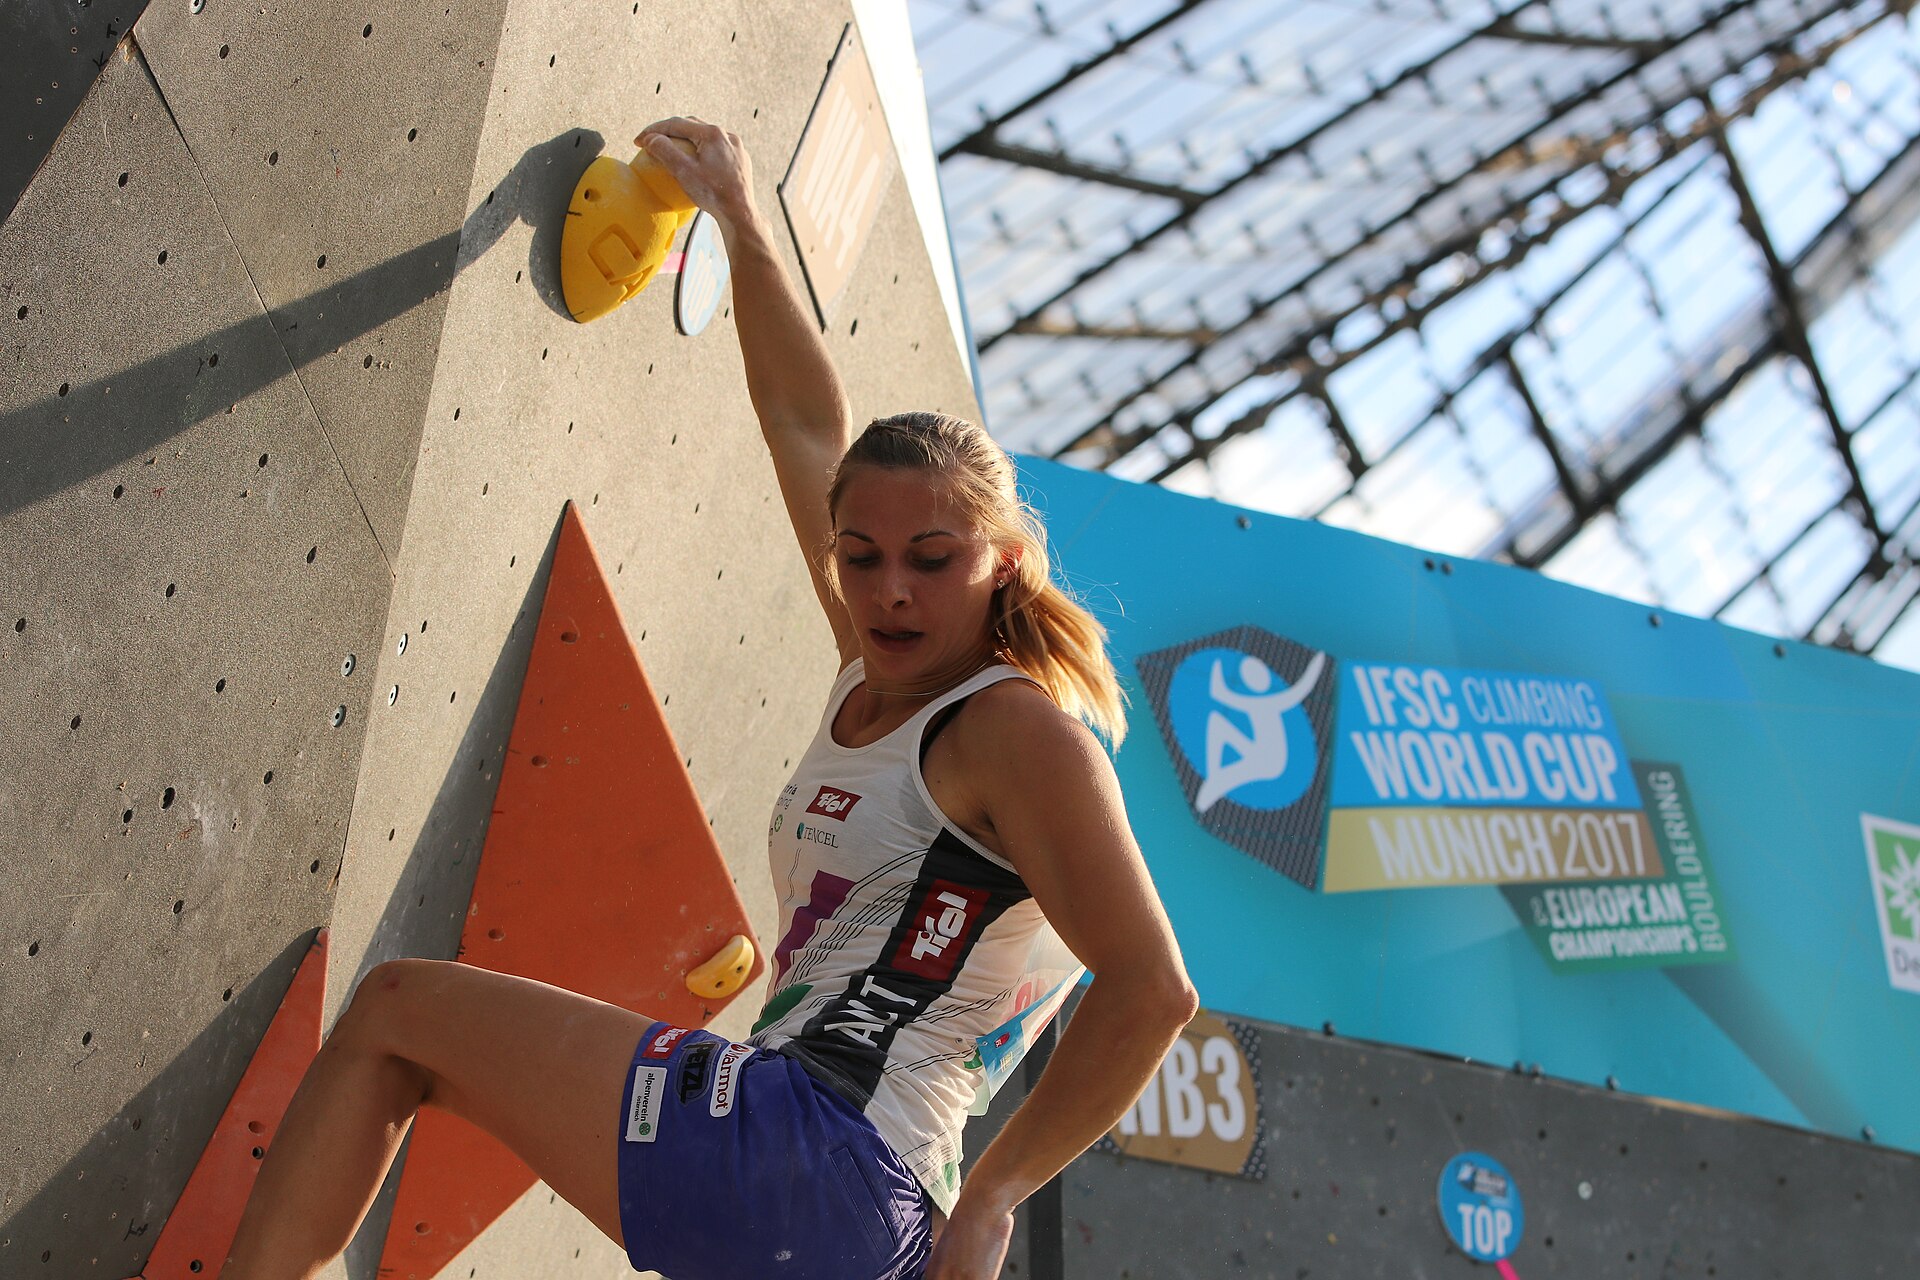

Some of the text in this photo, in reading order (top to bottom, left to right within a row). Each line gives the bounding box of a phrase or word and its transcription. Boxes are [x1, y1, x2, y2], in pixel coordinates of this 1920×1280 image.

[1353, 665, 1603, 730] IFSC CLIMBING
[1351, 731, 1618, 803] WORLD CUP
[804, 826, 839, 848] TENCEL
[1368, 813, 1645, 883] MUNICH 2017
[1648, 771, 1726, 951] BOULDERING
[1544, 883, 1687, 928] EUROPEAN
[1549, 925, 1698, 961] CHAMPIONSHIPS
[641, 1072, 655, 1122] alpenverein
[1458, 1203, 1513, 1257] TOP
